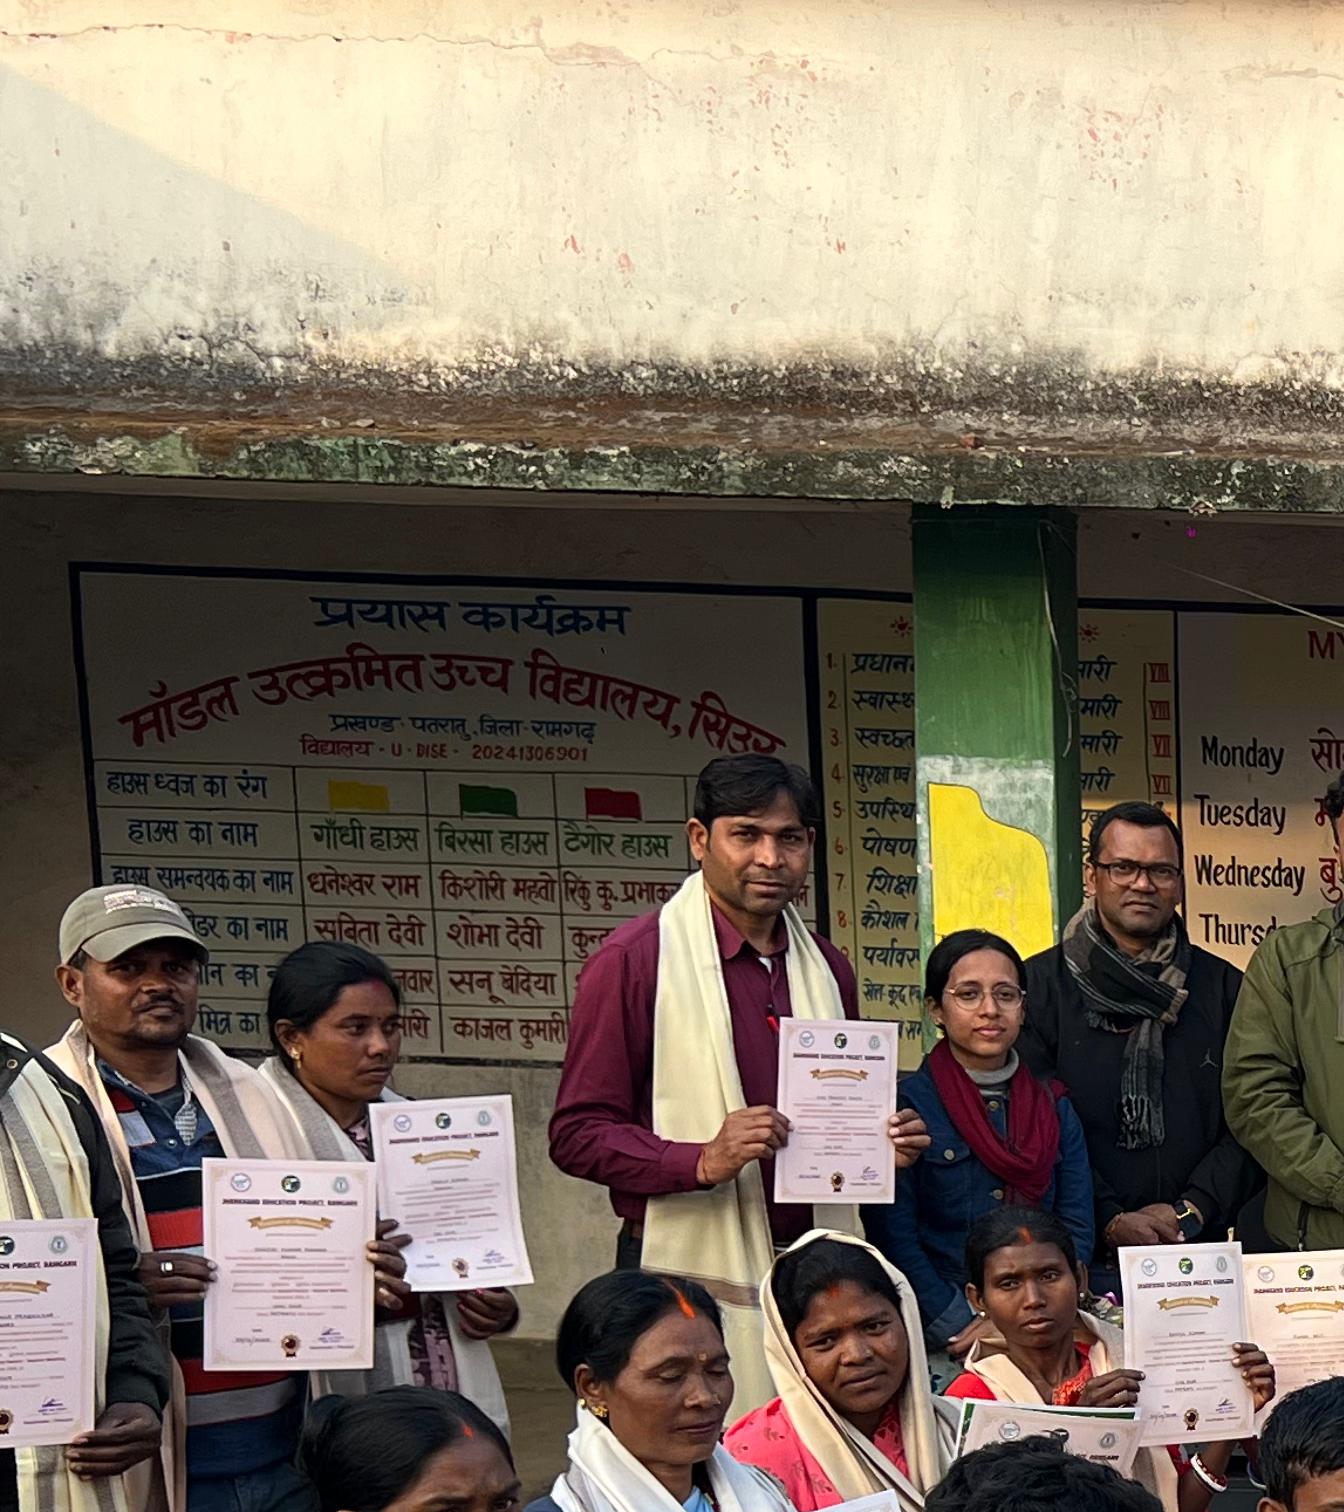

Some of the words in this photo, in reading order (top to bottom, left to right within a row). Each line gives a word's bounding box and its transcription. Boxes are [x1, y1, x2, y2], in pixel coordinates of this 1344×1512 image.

[310, 597, 451, 632] प्रयास
[459, 595, 631, 636] कार्यक्रम
[851, 653, 914, 674] प्रधान
[118, 681, 240, 747] मॉडल
[248, 643, 426, 705] उत्क्रमित
[430, 653, 513, 694] उच्च
[300, 734, 374, 756] विद्यालय
[416, 742, 448, 759] DISE
[472, 744, 588, 761] 20241306901
[1201, 735, 1284, 775] Monday
[106, 771, 150, 796] हाउस
[155, 773, 200, 798] ध्वज
[203, 773, 228, 798] का
[234, 769, 267, 798] रंग
[1193, 794, 1286, 835] Tuesday
[128, 819, 178, 845] हाउस
[186, 822, 213, 847] का
[220, 823, 259, 847] नाम
[311, 818, 364, 850] गाँधी
[370, 827, 420, 850] हाउस
[435, 821, 494, 853] बिरसा
[499, 830, 549, 856] हाउस
[562, 820, 615, 854] टैगोर
[621, 834, 673, 857] हाउस
[233, 868, 256, 892] का
[263, 873, 294, 895] नाम
[382, 874, 421, 899] राम
[438, 868, 506, 902] किशोरी
[512, 870, 556, 905] महतो
[1194, 855, 1305, 897] Wednesday
[226, 916, 249, 941] का
[257, 919, 289, 942] नाम
[385, 914, 428, 947] देवी
[448, 915, 500, 950] शोभा
[505, 915, 545, 951] देवी
[863, 938, 920, 970] पर्यावर
[234, 964, 259, 988] का
[239, 1011, 261, 1035] का
[450, 1017, 512, 1042] काजल
[520, 1011, 568, 1049] कुमारी
